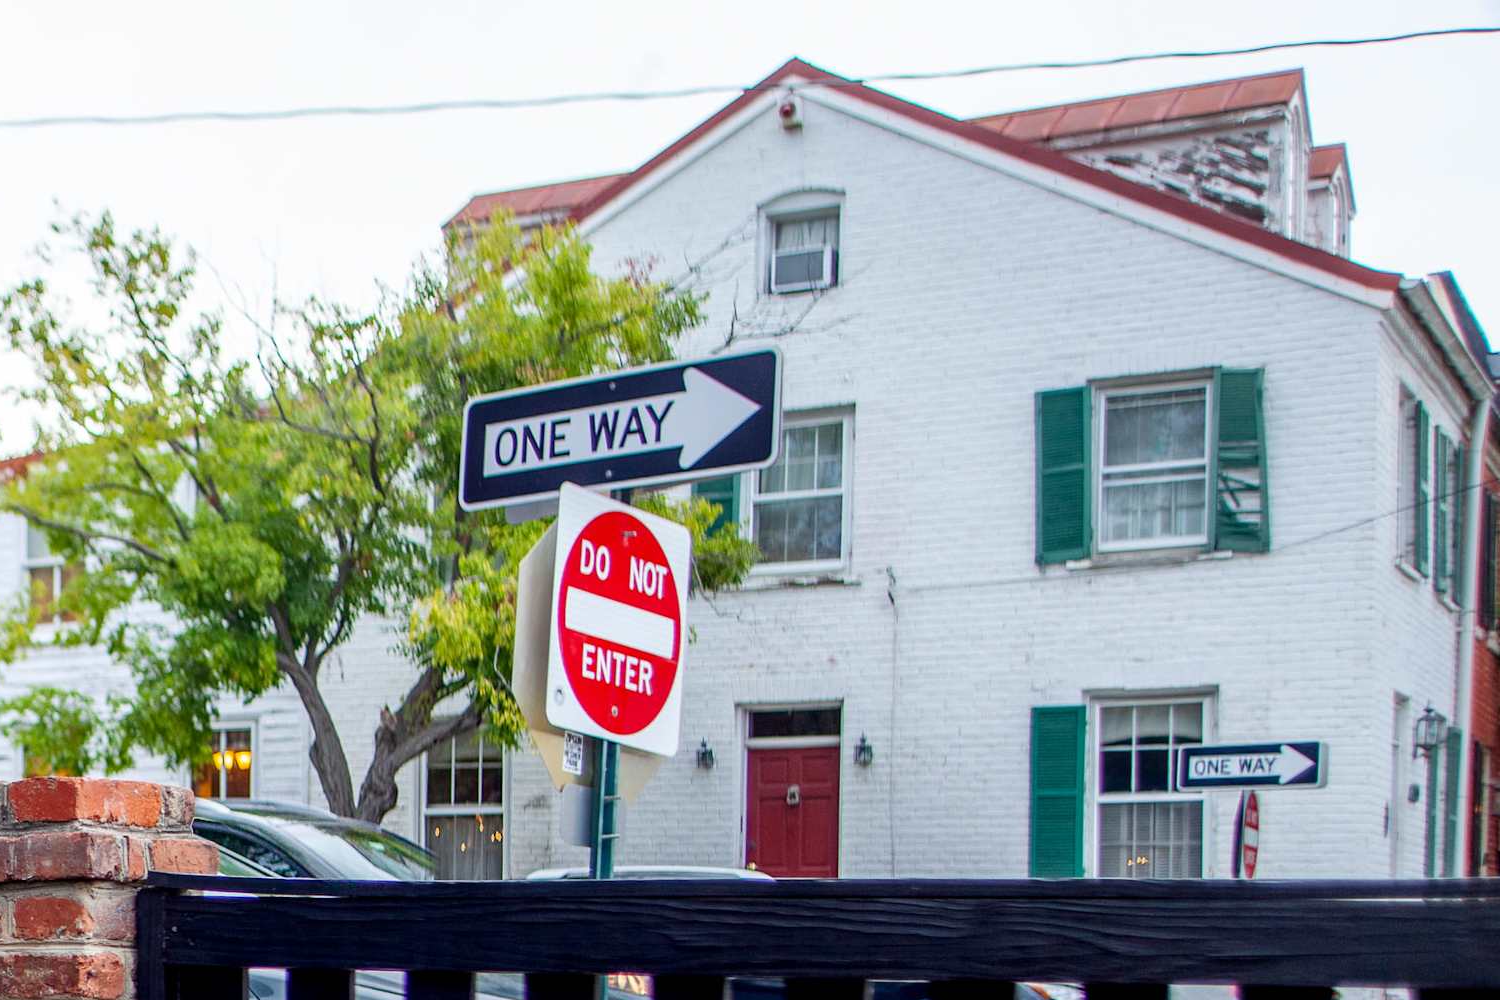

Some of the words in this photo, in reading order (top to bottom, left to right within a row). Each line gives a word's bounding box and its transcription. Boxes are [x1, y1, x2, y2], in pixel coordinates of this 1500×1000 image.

[495, 417, 571, 467] ONE
[589, 400, 675, 453] WAY
[579, 538, 611, 581] DO
[628, 555, 669, 600] NOT
[581, 642, 653, 696] ENTER
[1194, 759, 1231, 776] ONE
[1238, 757, 1277, 774] WAY
